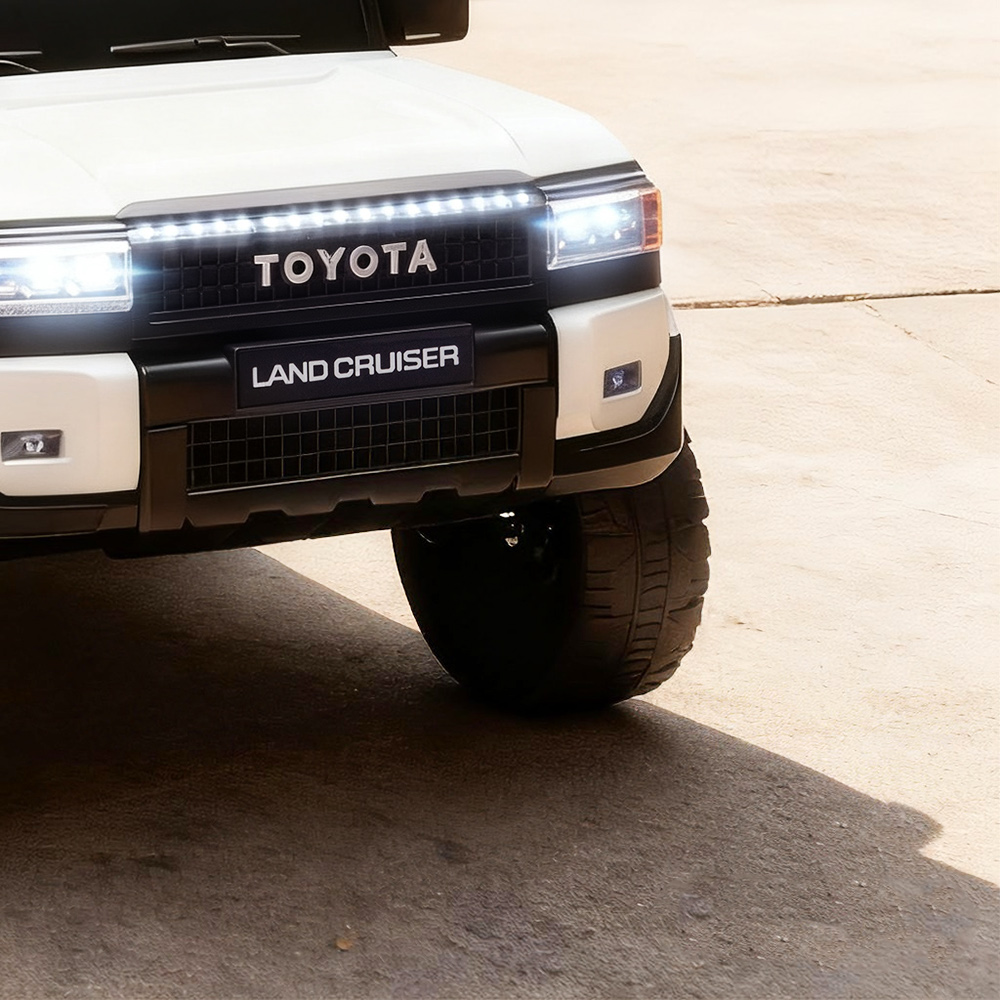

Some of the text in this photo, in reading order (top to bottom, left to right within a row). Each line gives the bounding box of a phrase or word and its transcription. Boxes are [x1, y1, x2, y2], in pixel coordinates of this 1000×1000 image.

[254, 239, 437, 287] TOYOTA
[252, 345, 460, 388] LAND CRUISER
